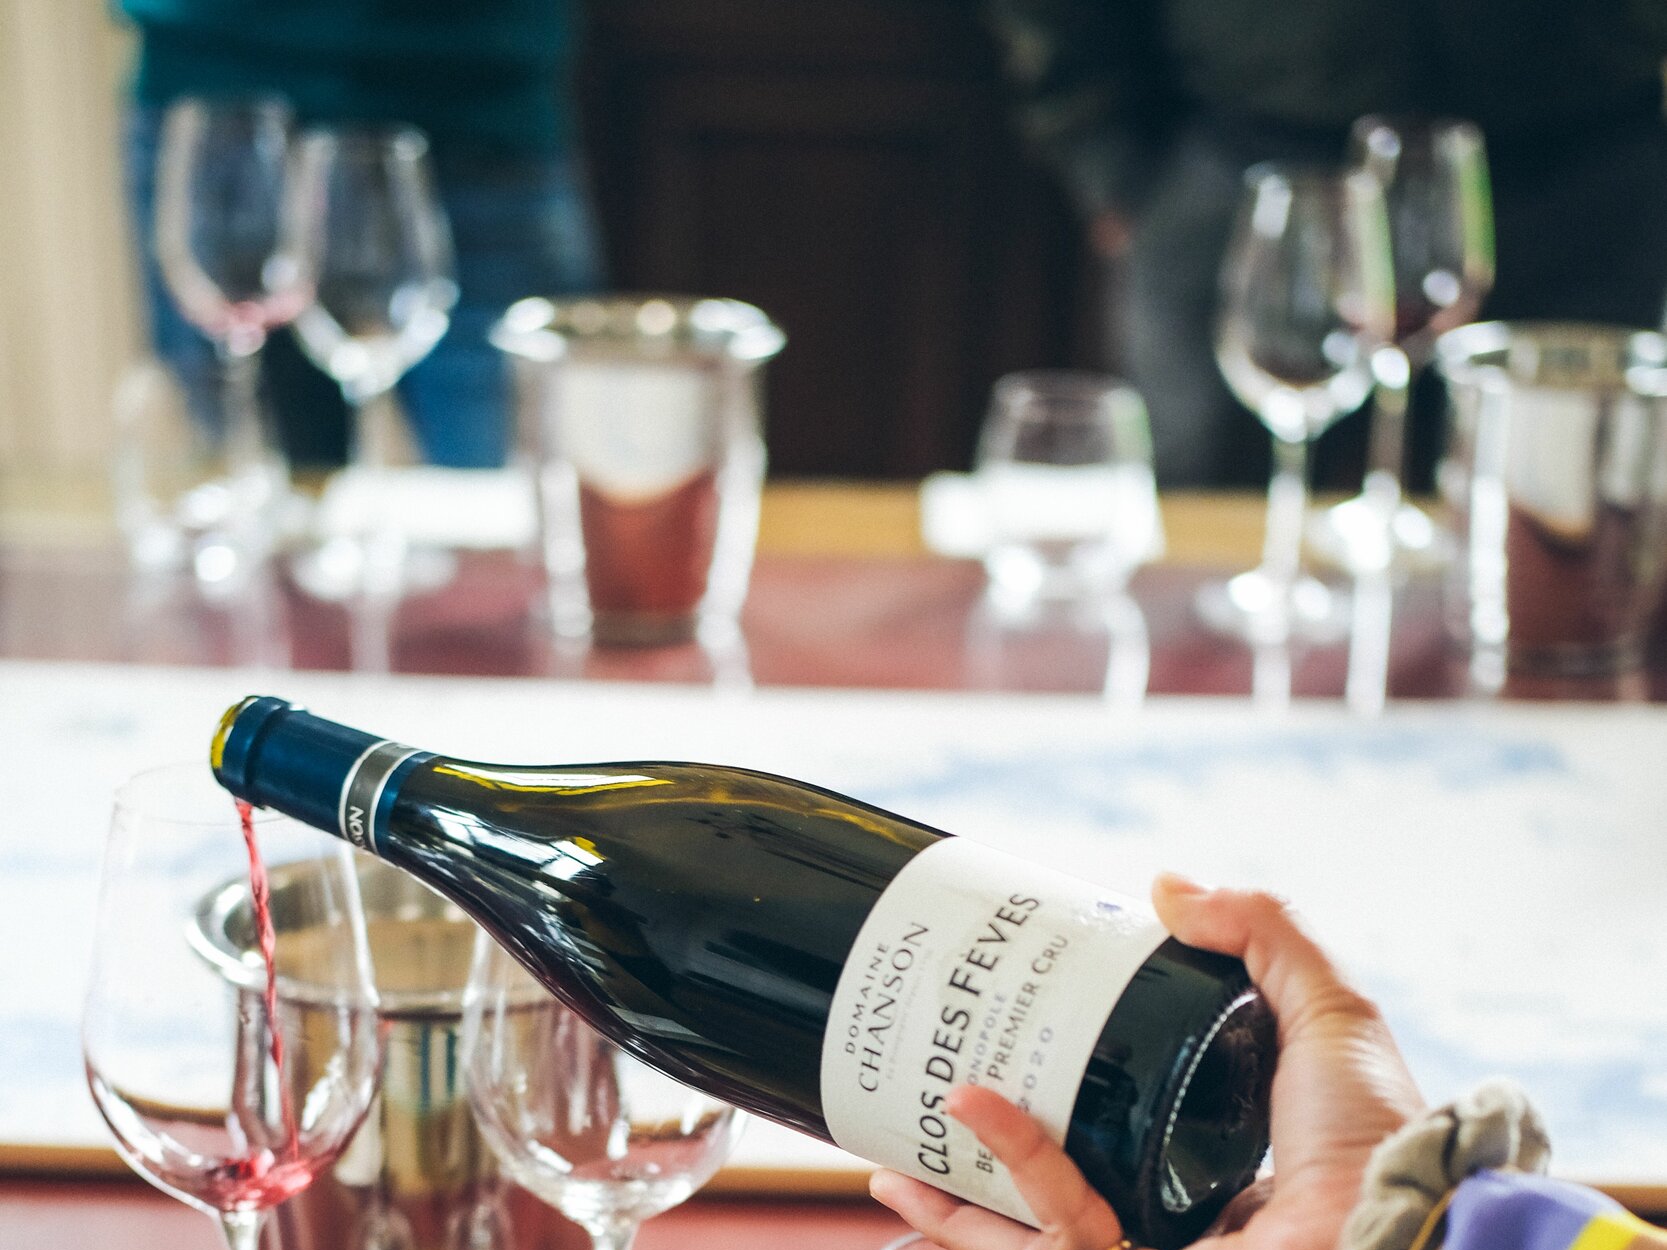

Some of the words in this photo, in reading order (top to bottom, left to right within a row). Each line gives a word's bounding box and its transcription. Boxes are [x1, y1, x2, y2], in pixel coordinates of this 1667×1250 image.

[948, 893, 1041, 998] FÈVES
[845, 942, 890, 1055] DOMAINE
[858, 921, 930, 1092] CHANSON
[925, 1005, 971, 1083] DES
[966, 993, 1008, 1086] ONOPOLE
[986, 981, 1041, 1081] PREMIER
[1031, 934, 1070, 977] CRU
[917, 1091, 951, 1175] CLOS
